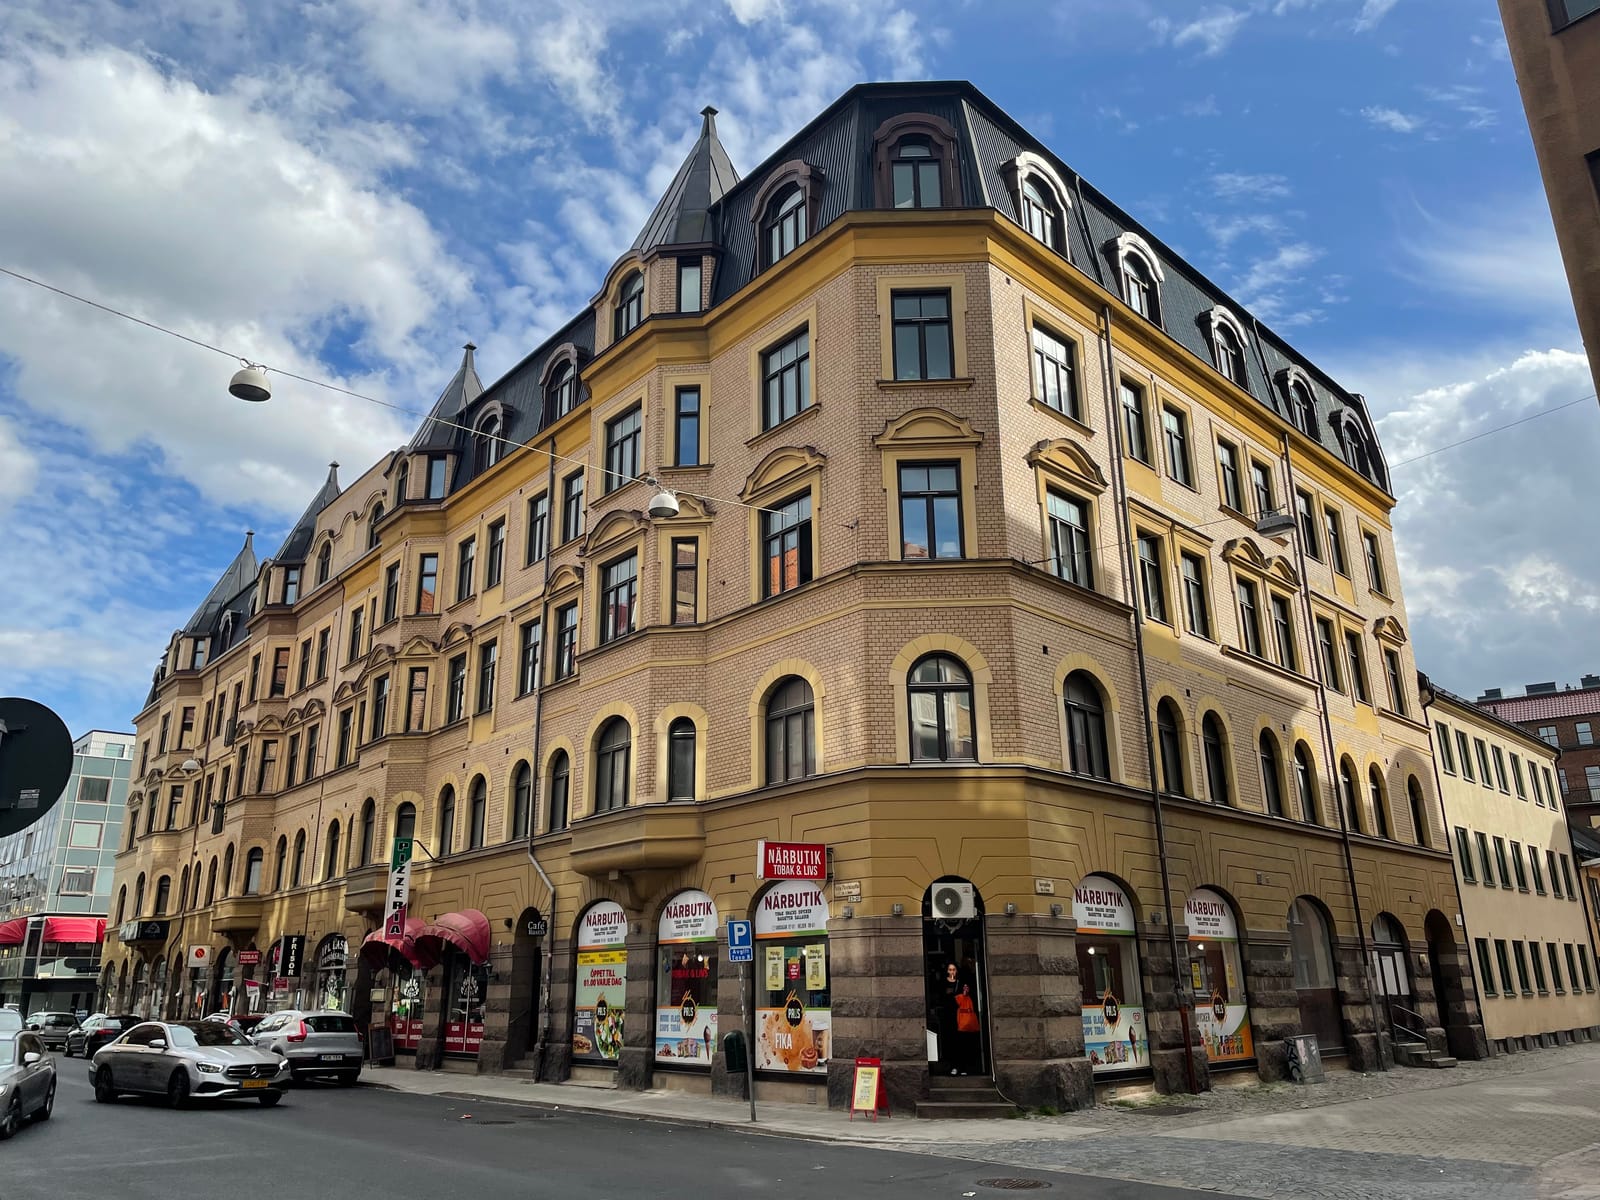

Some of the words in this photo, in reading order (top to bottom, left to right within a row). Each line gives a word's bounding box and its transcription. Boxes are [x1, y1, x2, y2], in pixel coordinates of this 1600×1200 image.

[768, 847, 821, 864] NÄRBUTIK
[773, 864, 794, 875] TOBAK
[796, 865, 802, 875] &
[804, 865, 818, 876] LIVS
[390, 842, 409, 934] PIZZERIA
[1075, 886, 1124, 907] NÄRBUTIK
[764, 891, 822, 910] NÄRBUTIK
[1186, 898, 1226, 916] NÄRBUTIK
[666, 902, 712, 919] NÄRBUTIK
[528, 920, 545, 930] Café
[586, 912, 625, 927] NÄRBUTIK
[734, 923, 747, 944] P
[590, 969, 605, 977] ÖPPET
[606, 969, 615, 977] TILL
[612, 978, 622, 986] DAG
[775, 1033, 792, 1049] FIKA
